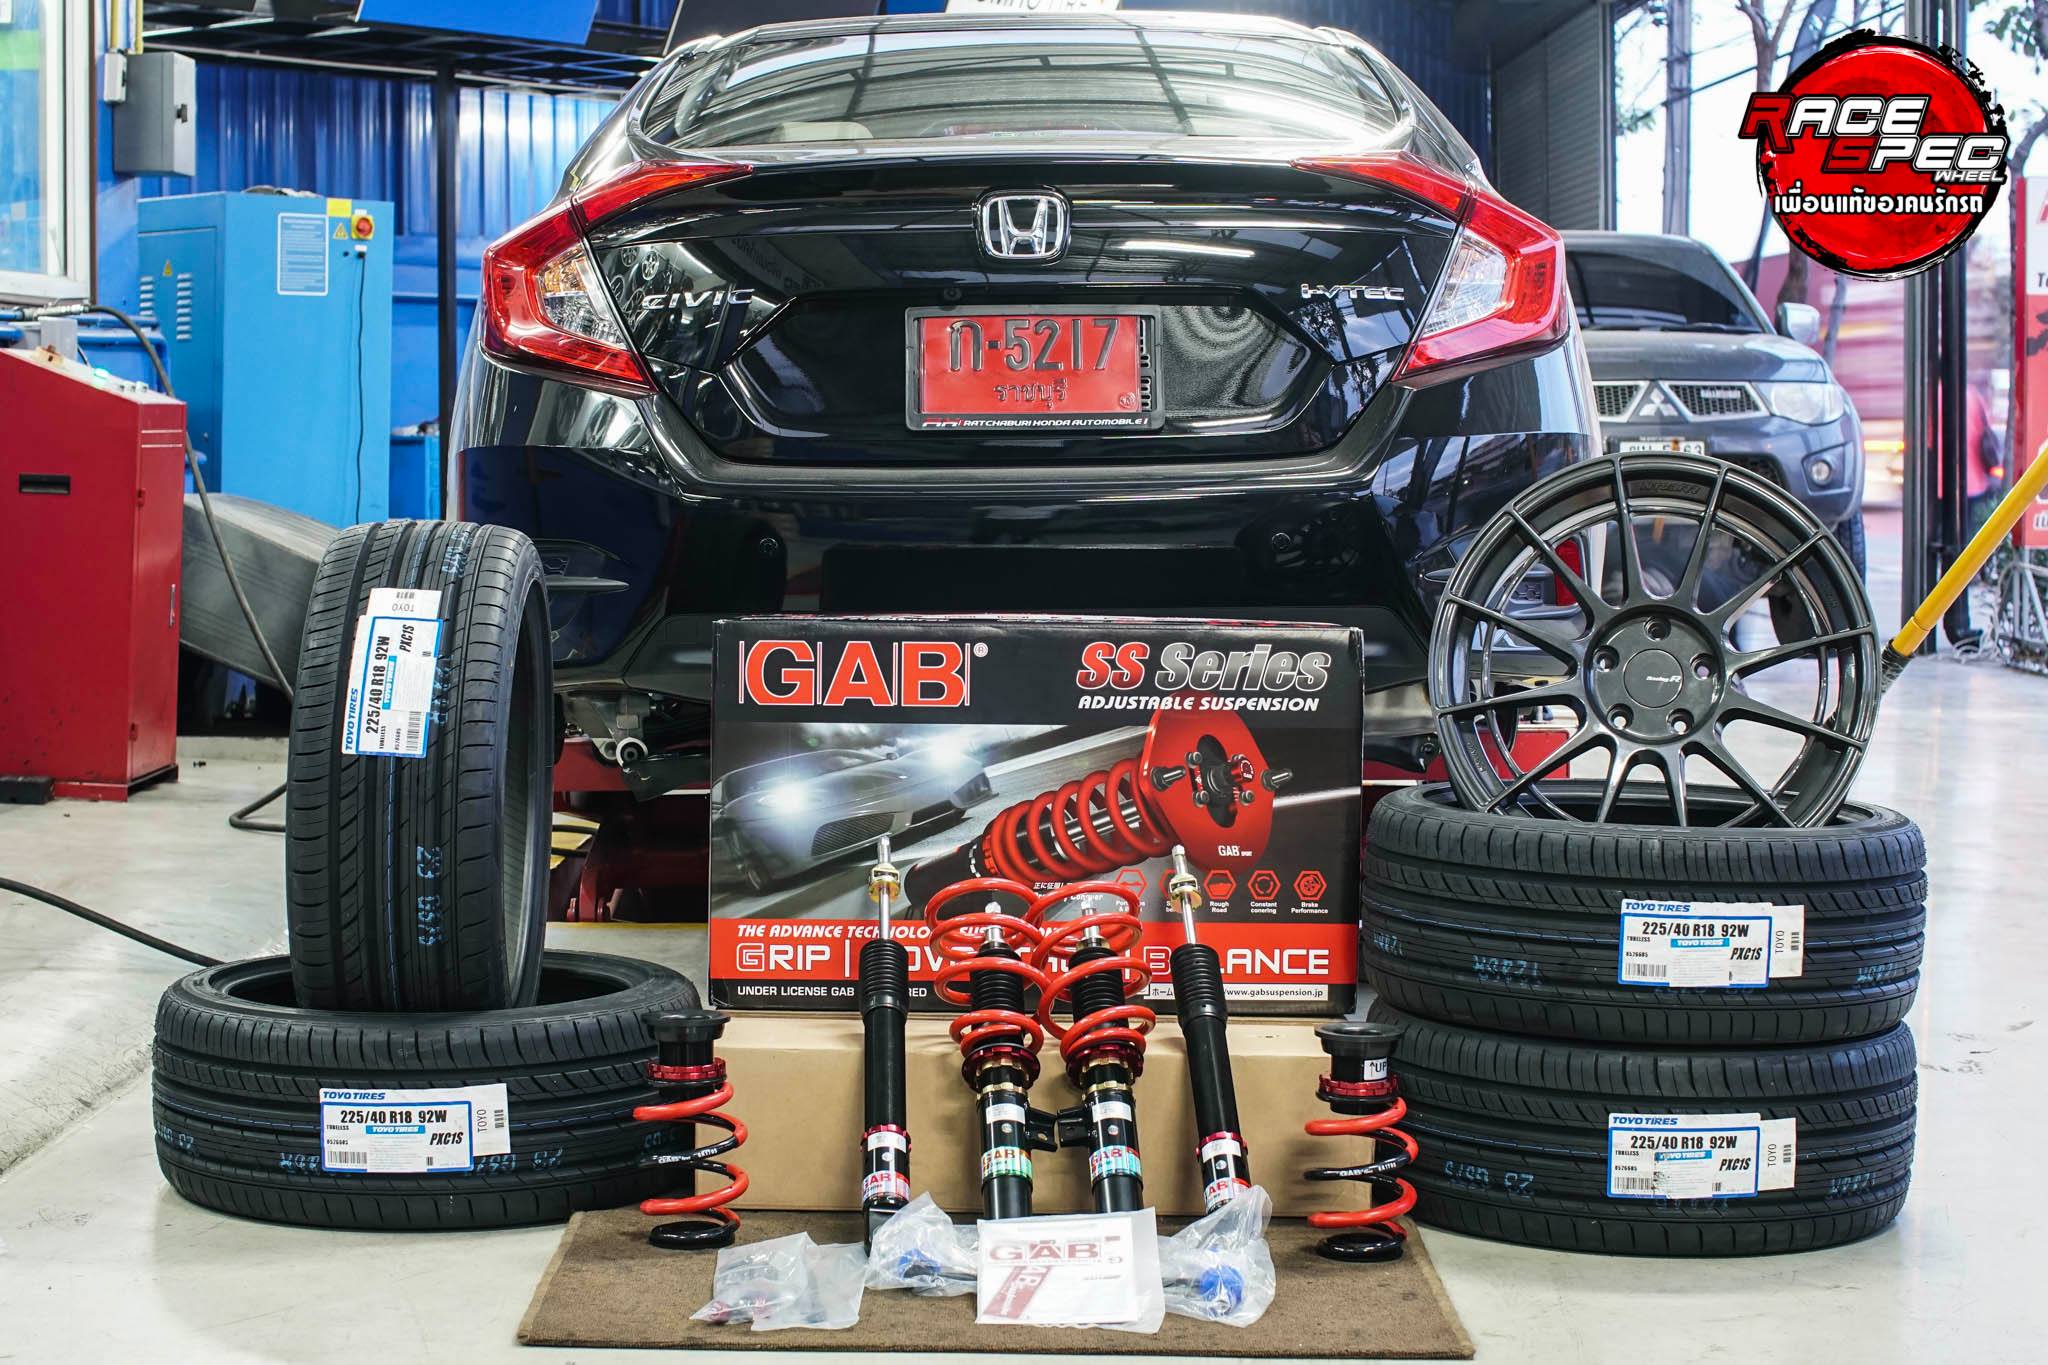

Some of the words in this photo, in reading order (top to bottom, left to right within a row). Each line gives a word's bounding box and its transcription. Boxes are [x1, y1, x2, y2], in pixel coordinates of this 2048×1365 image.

[641, 289, 755, 309] CIVIC
[994, 378, 1068, 409] ราชบุรี
[963, 419, 1031, 427] RATCHABURI
[1033, 419, 1071, 427] HONDA
[1071, 418, 1142, 426] AUTOMOBILE
[391, 605, 415, 613] TOYO
[400, 624, 415, 653] PXC1S
[376, 636, 391, 660] 92W
[1076, 641, 1150, 690] SS
[1155, 642, 1332, 692] Series
[371, 665, 386, 687] R18
[349, 688, 359, 720] TIRES
[366, 688, 383, 734] 225/40
[1078, 696, 1195, 710] ADJUSTABLE
[1199, 697, 1320, 711] SUSPENSION
[345, 721, 355, 751] TOYO
[1625, 902, 1655, 911] TOYO
[1657, 904, 1691, 912] TIRES
[738, 925, 766, 937] THE
[769, 925, 843, 938] ADVANCE
[847, 925, 931, 939] TECHOLO
[1642, 921, 1690, 938] 225/40
[1693, 924, 1715, 937] R18
[1721, 924, 1749, 938] 92W
[1775, 930, 1784, 954] TOYO
[736, 943, 831, 971] GRIP
[1143, 946, 1330, 975] BANCE
[1730, 947, 1763, 960] PXC1S
[737, 986, 777, 996] UNDER
[781, 986, 827, 996] LICENSE
[831, 987, 855, 996] GAB
[1375, 1062, 1387, 1073] UP
[323, 1091, 352, 1099] TOYO
[353, 1092, 386, 1100] TIRES
[340, 1110, 386, 1124] 225/40
[390, 1110, 412, 1123] R18
[418, 1109, 447, 1123] 92W
[477, 1109, 487, 1132] TOYO
[1613, 1116, 1642, 1125] TOYO
[1644, 1117, 1678, 1125] TIRES
[430, 1132, 464, 1145] PXC1S
[1630, 1136, 1678, 1149] 225/40
[1681, 1136, 1703, 1149] R18
[1709, 1136, 1738, 1149] 92W
[1767, 1143, 1777, 1167] TOYO
[1719, 1158, 1750, 1171] PXC1S
